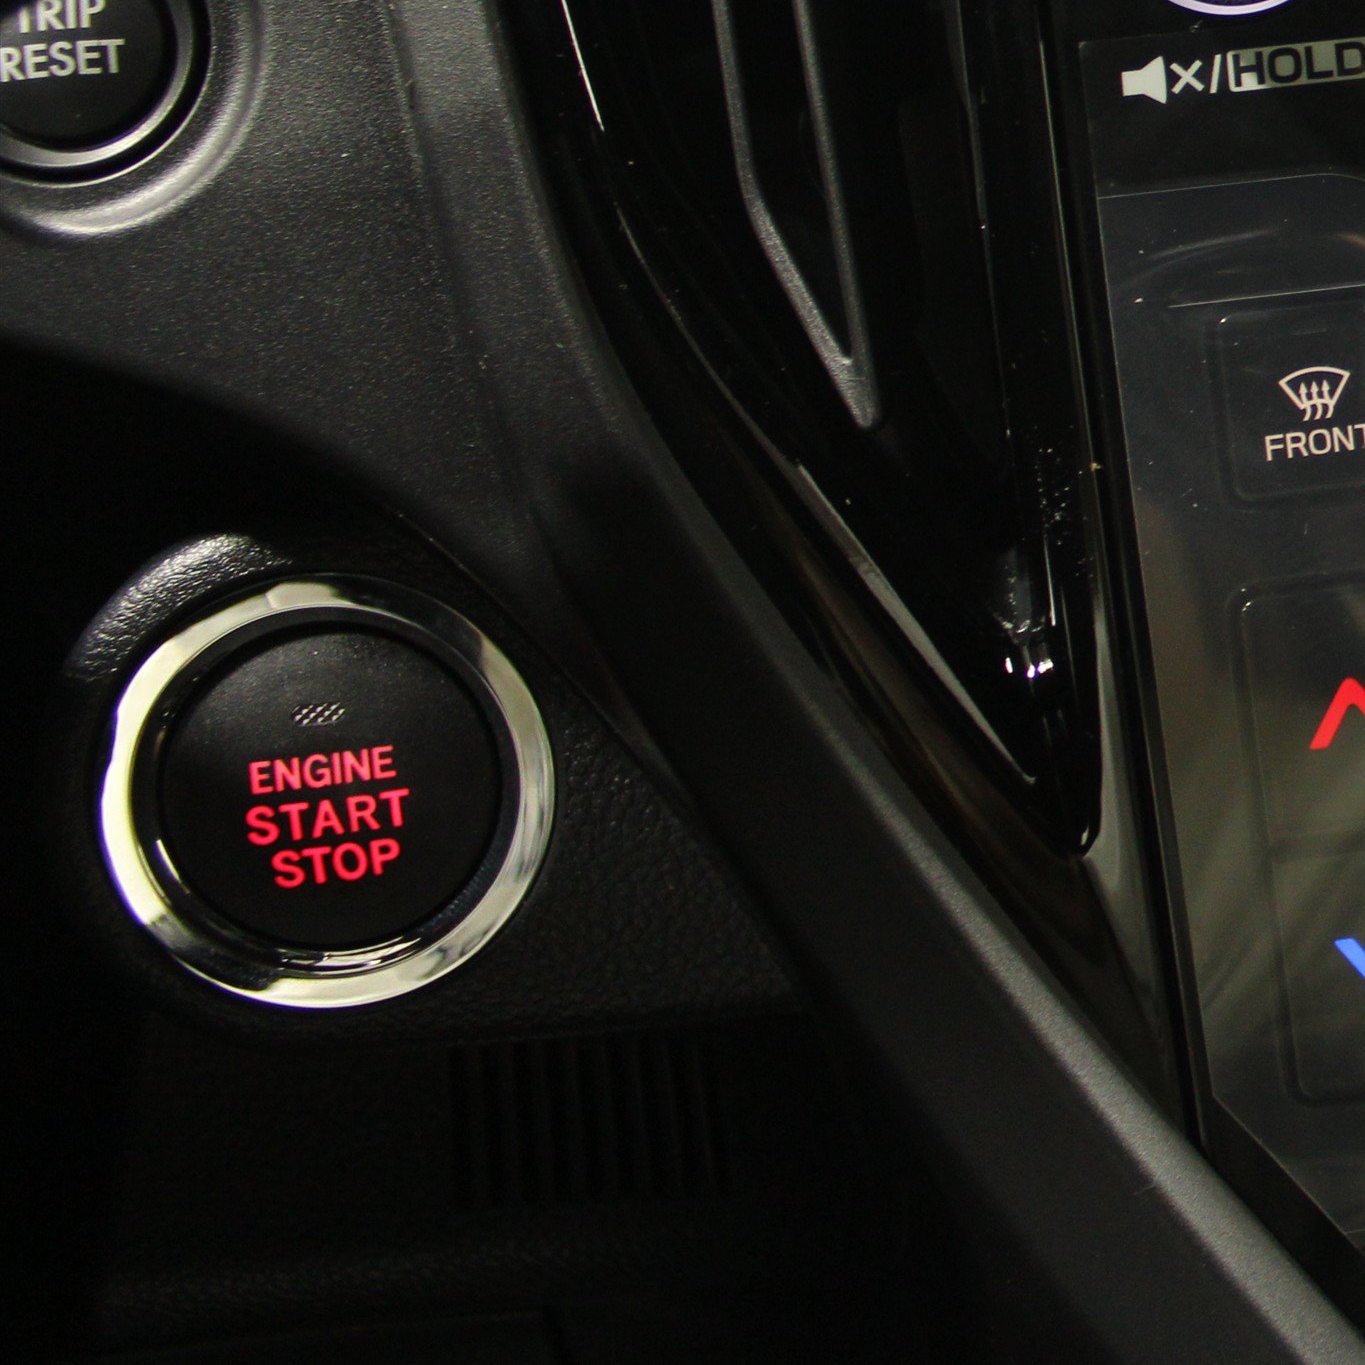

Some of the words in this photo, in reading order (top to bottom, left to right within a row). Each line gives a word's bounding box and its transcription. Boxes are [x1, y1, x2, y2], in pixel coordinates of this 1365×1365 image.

[0, 38, 126, 83] RESET
[248, 744, 398, 796] ENGINE
[244, 788, 410, 846] START
[270, 837, 402, 889] STOP
